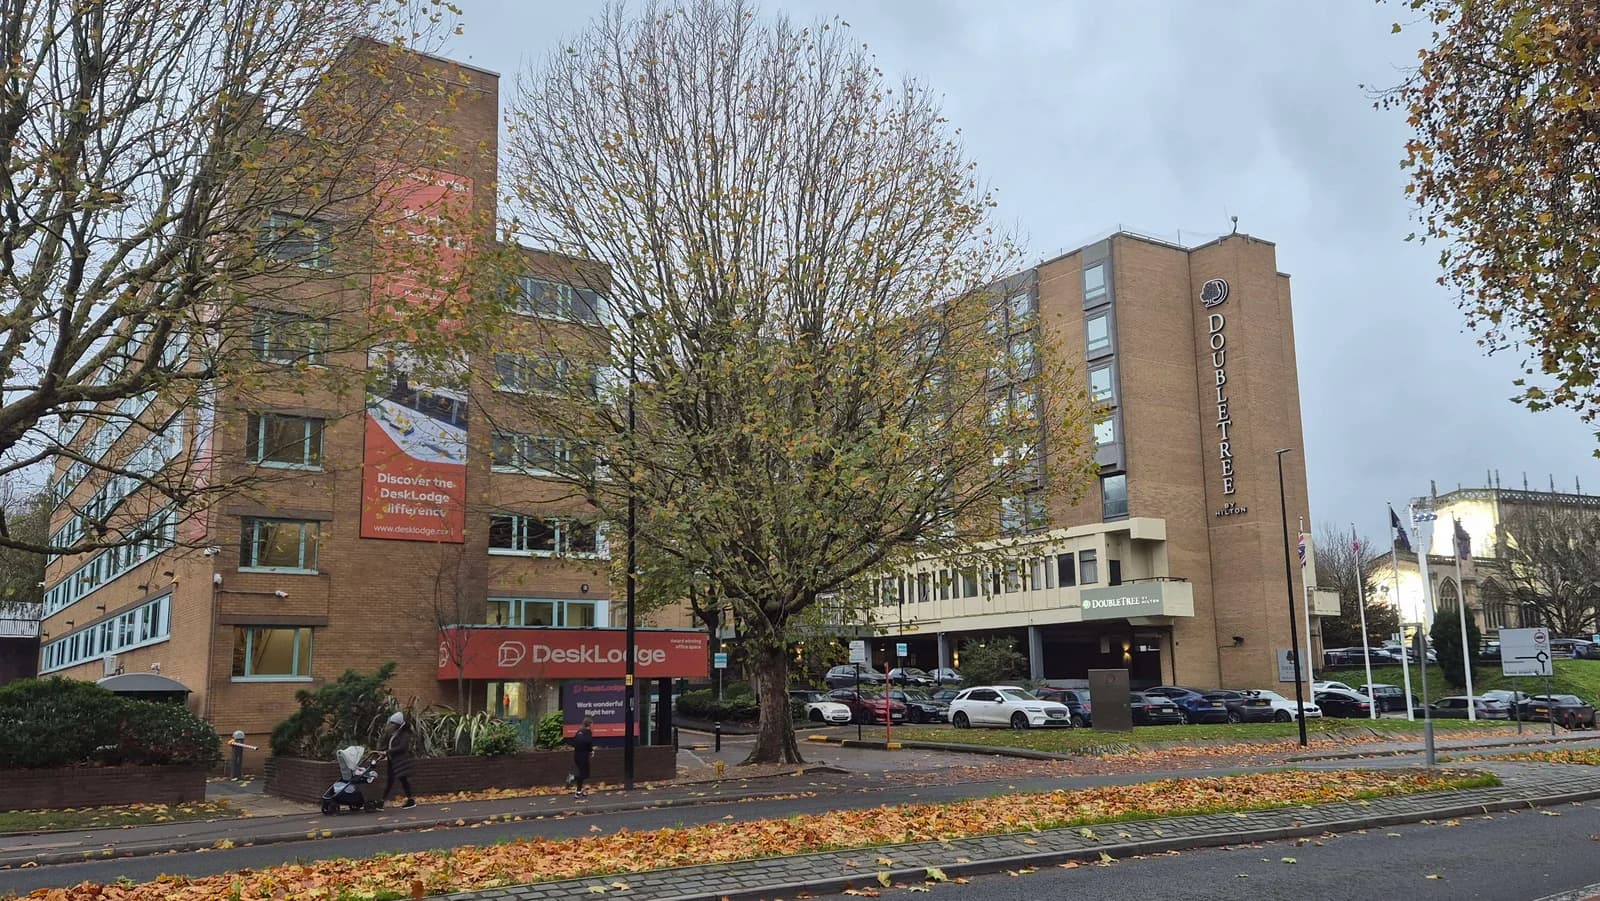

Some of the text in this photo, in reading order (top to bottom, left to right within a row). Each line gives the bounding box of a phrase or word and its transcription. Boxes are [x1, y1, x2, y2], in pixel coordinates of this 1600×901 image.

[1208, 313, 1235, 494] DOUBLETREE
[377, 473, 454, 489] Discover the
[380, 488, 450, 504] DeskLodge
[1216, 506, 1248, 517] HILTON
[593, 700, 624, 708] wonderful
[584, 709, 601, 717] Right
